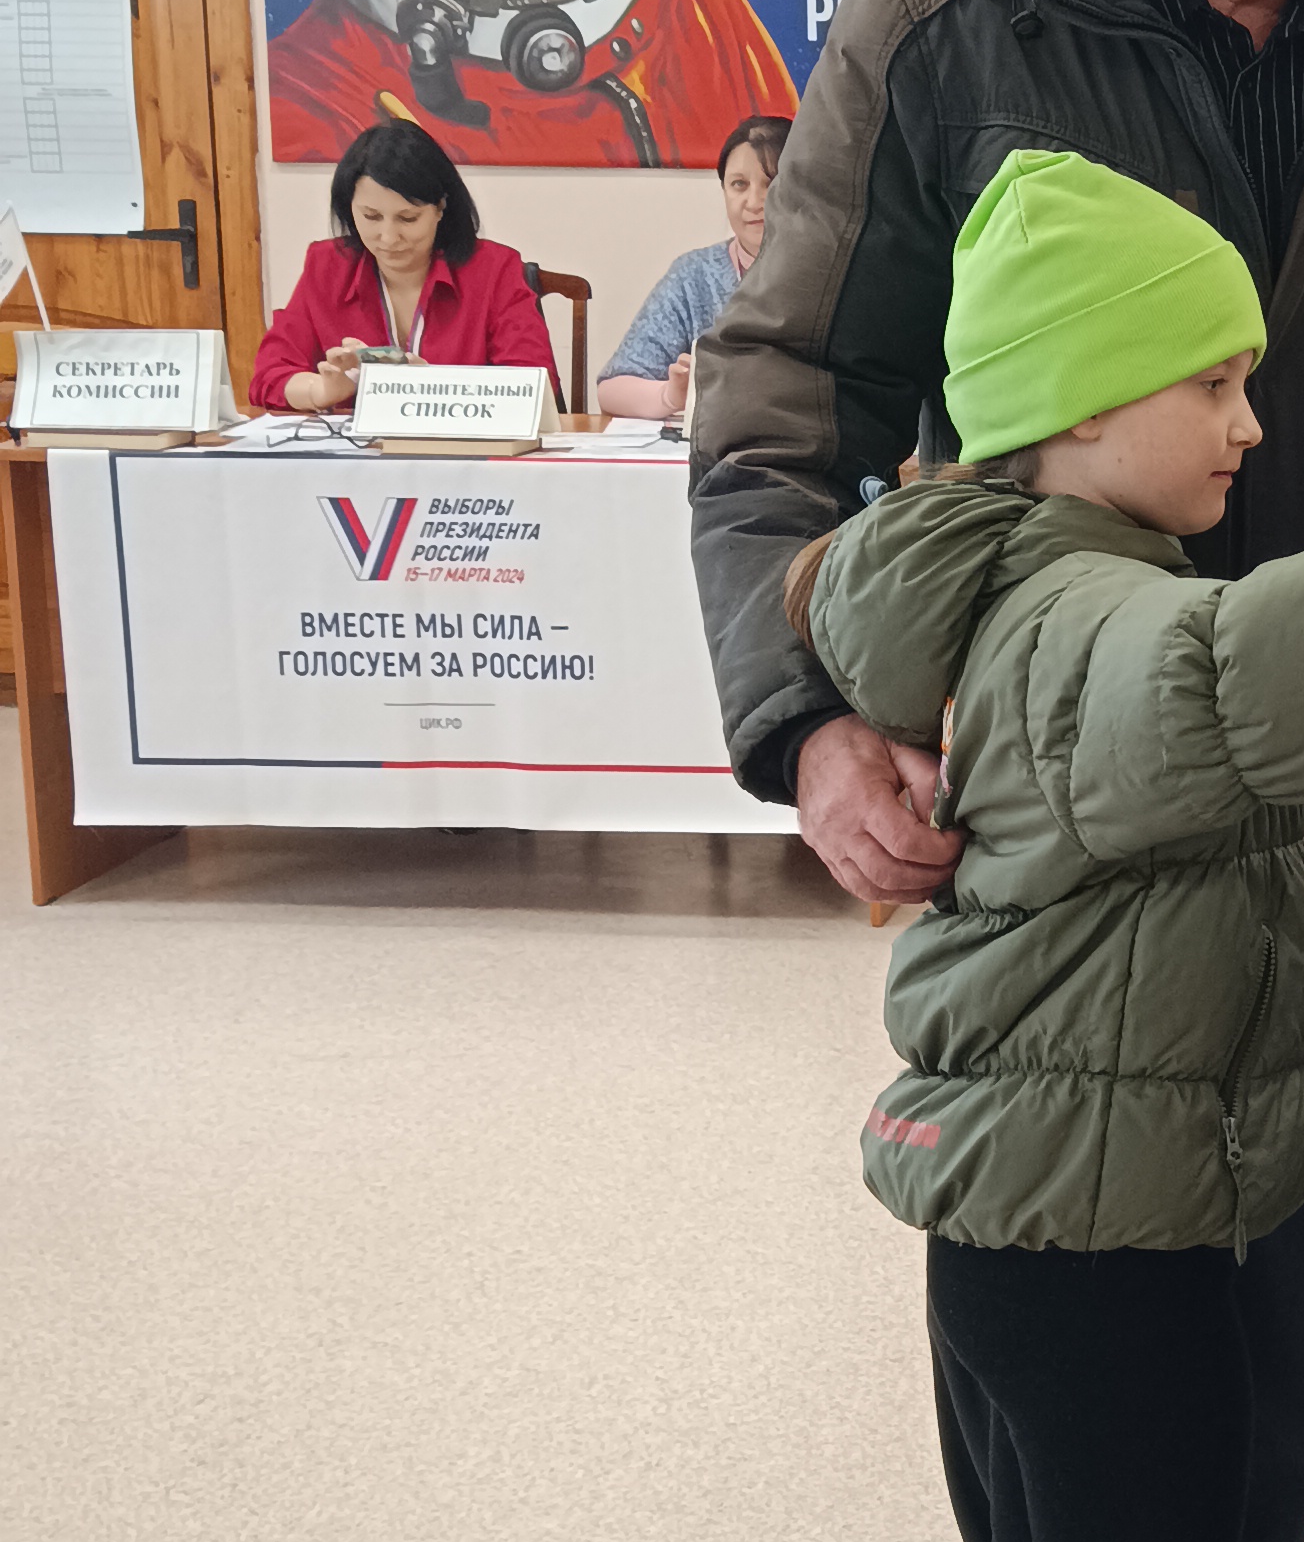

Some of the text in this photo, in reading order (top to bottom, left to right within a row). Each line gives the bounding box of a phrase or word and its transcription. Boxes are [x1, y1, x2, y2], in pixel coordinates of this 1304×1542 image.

[55, 361, 181, 378] СЕКРЕТАРЬ
[52, 384, 180, 399] КОМИССИИ
[366, 382, 534, 398] ДОПОЛНИТЕЛЬНЫЙ
[400, 402, 496, 419] СПИСОК
[428, 497, 514, 517] ВЫБОРЫ
[419, 521, 541, 541] ПРЕЗИДЕНТА
[411, 544, 490, 562] РОССИИ
[443, 567, 491, 583] МАРТА
[492, 568, 525, 584] 2024
[300, 611, 406, 639] ВМЕСТЕ
[415, 612, 464, 639] МЫ
[472, 613, 543, 641] СИЛА
[278, 650, 595, 681] ГОЛОСУЕМ ЗА РОССИЮ!
